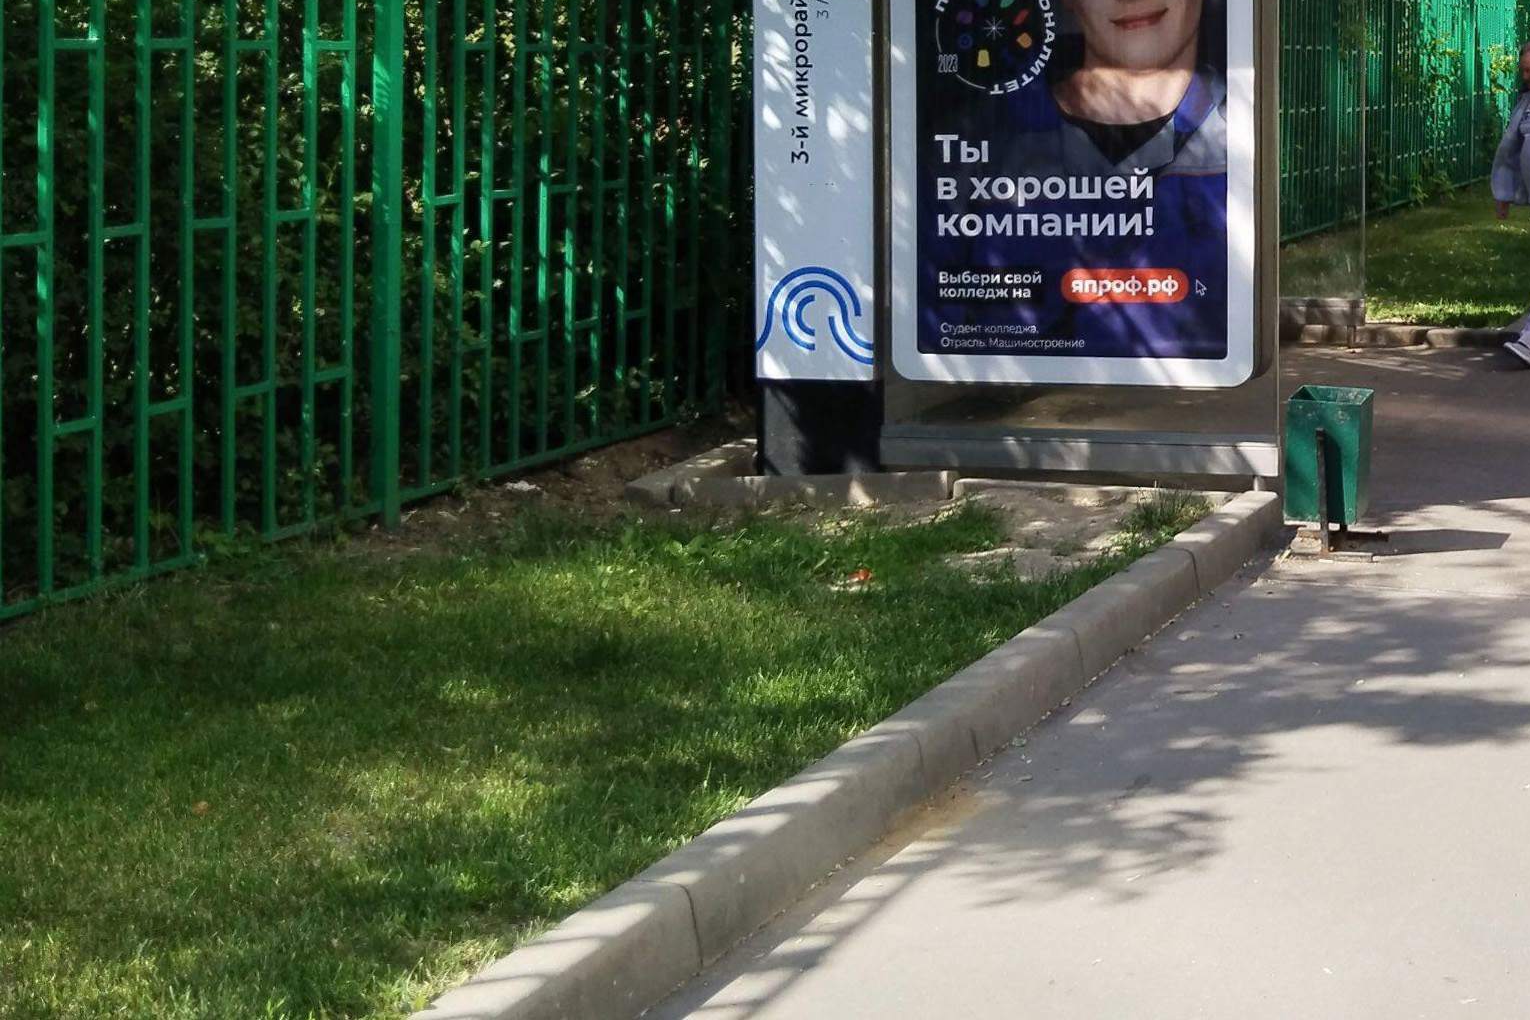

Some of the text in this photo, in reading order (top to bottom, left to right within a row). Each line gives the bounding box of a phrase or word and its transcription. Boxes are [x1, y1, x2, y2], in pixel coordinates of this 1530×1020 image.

[816, 9, 830, 19] 3
[938, 54, 959, 73] 2023
[791, 126, 810, 164] 3-й
[934, 134, 989, 163] Ты
[937, 167, 1154, 208] в хорошей
[938, 206, 1155, 237] компании!
[939, 271, 1042, 287] Выбери свой
[1071, 275, 1180, 298] япроф.рф
[939, 287, 1032, 301] колледж на
[940, 322, 982, 336] Студент
[989, 337, 1086, 350] Машиностроение
